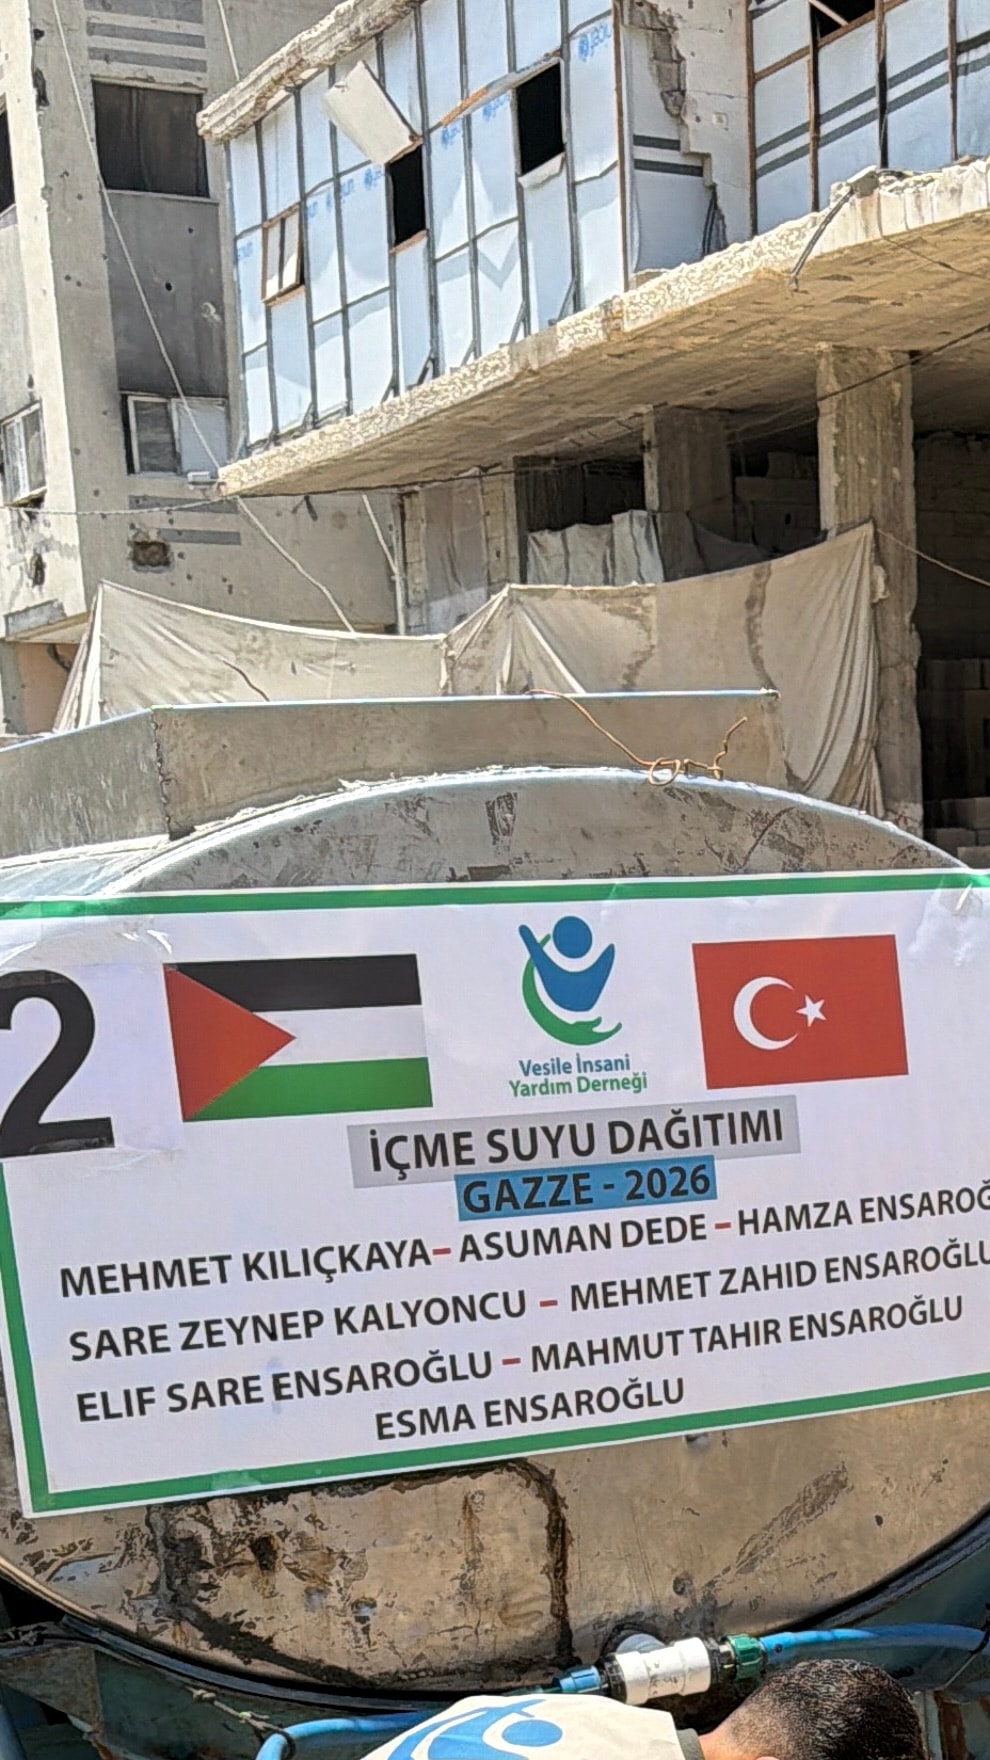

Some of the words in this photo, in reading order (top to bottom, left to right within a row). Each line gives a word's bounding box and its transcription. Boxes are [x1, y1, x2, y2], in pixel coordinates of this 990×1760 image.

[0, 969, 115, 1159] 2
[509, 1077, 571, 1098] Yardım
[576, 1069, 648, 1094] Derneği
[519, 1058, 573, 1078] Vesile
[575, 1053, 631, 1074] İnsani
[369, 1129, 476, 1181] İÇME
[486, 1122, 595, 1164] SUYU
[607, 1108, 783, 1155] DAĞITIMI
[463, 1172, 594, 1214] GAZZE
[624, 1163, 711, 1201] 2026
[60, 1254, 232, 1298] MEHMET
[459, 1222, 612, 1263] ASUMAN
[620, 1213, 707, 1248] DEDE
[738, 1200, 853, 1236] HAMZA
[69, 1323, 171, 1362] SARE
[178, 1309, 324, 1351] ZEYNEP
[333, 1289, 526, 1336] KALYONCU
[570, 1270, 712, 1312] MEHMET
[719, 1260, 817, 1296] ZAHID
[76, 1386, 156, 1422] ELIF
[166, 1374, 264, 1413] SARE
[271, 1350, 493, 1402] ENSAROĞLU
[531, 1329, 685, 1373] MAHMUT
[690, 1318, 782, 1354] TAHIR
[789, 1295, 962, 1342] ENSAROĞLU
[375, 1404, 476, 1442] ESMA
[484, 1376, 684, 1429] ENSAROĞLU
